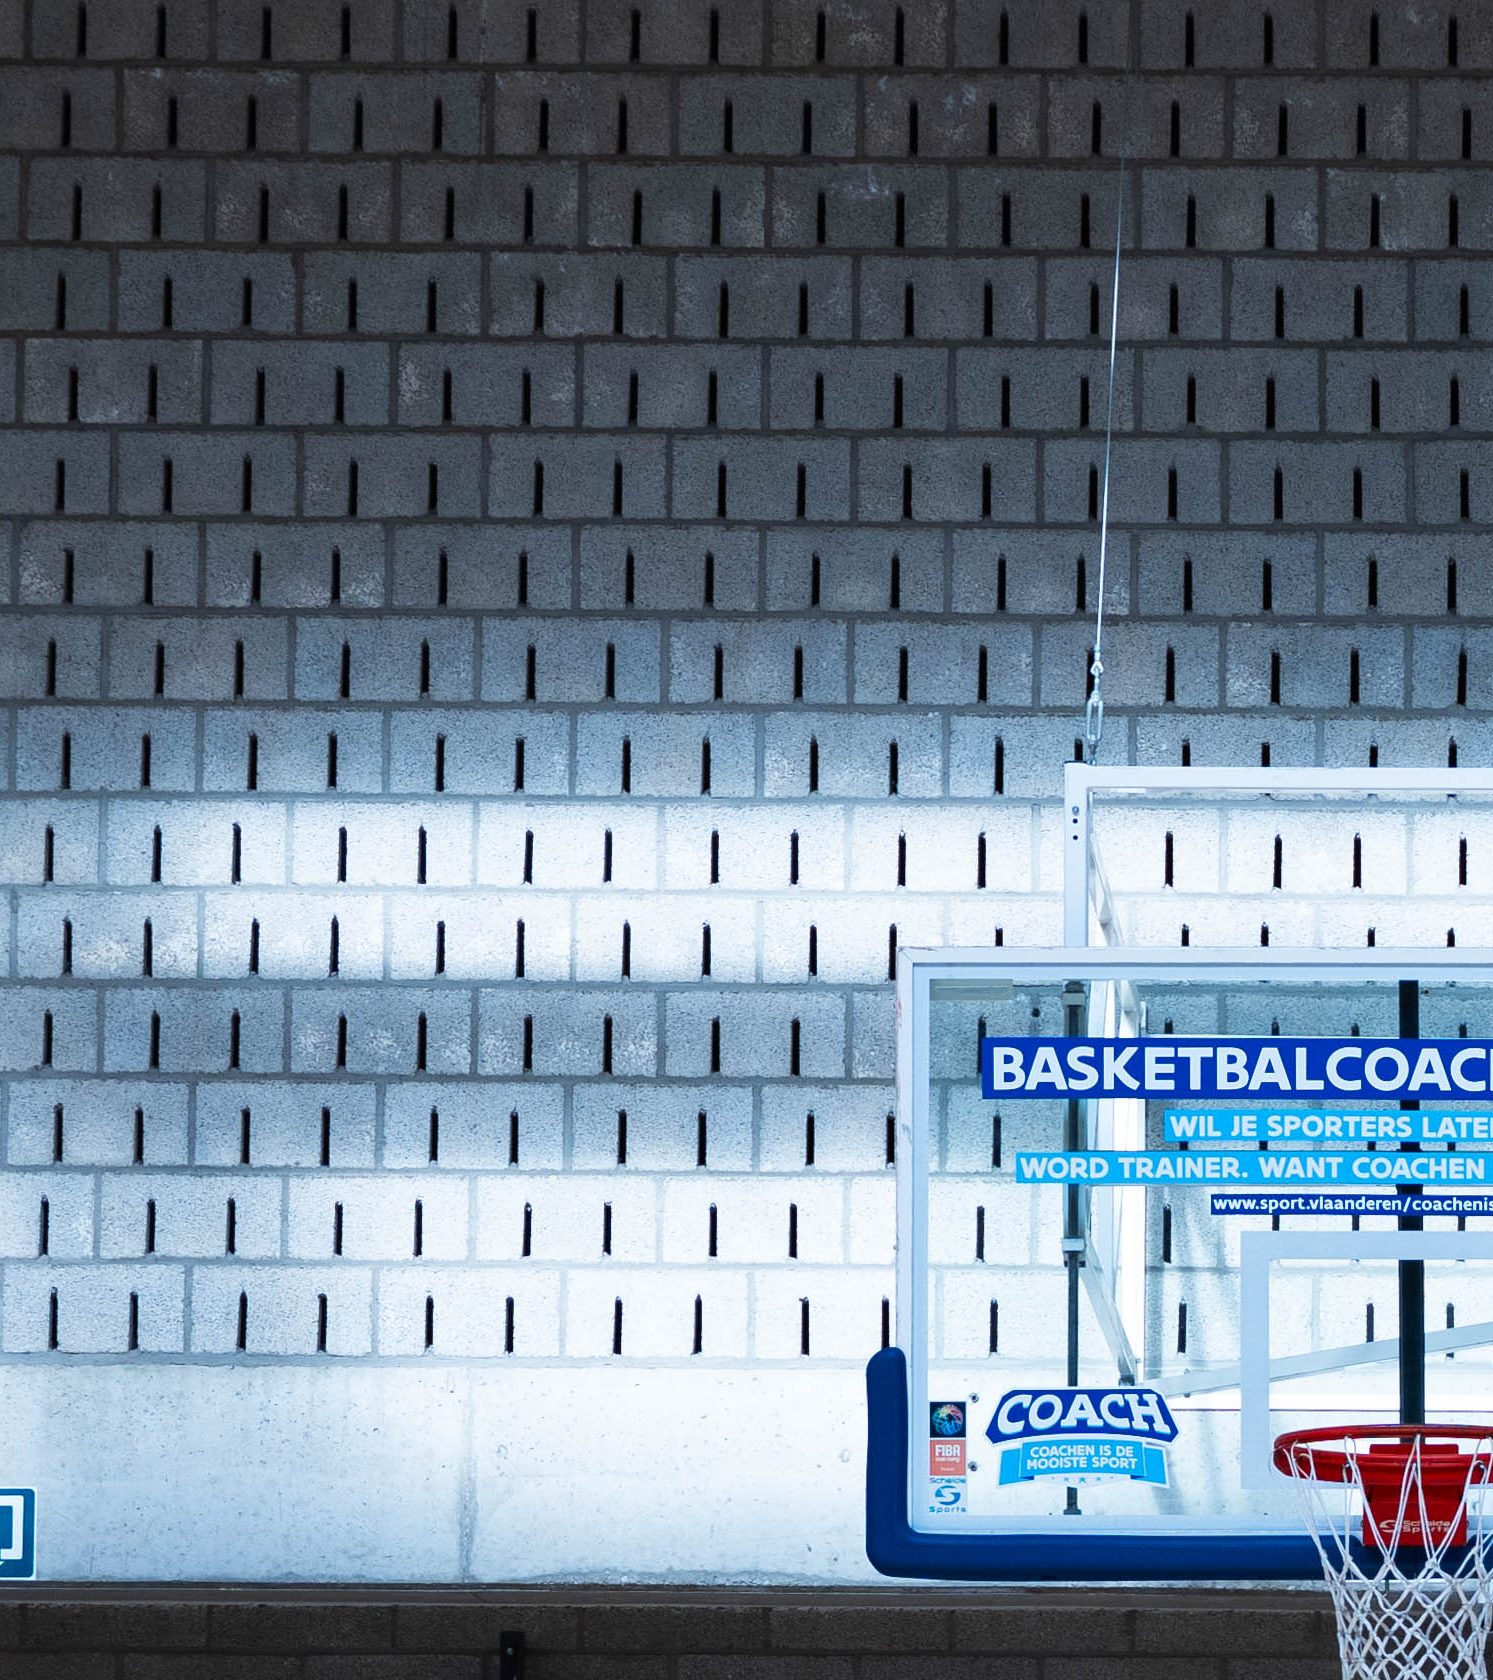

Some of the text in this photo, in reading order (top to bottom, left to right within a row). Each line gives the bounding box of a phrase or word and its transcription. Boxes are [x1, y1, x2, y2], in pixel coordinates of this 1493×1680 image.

[1169, 1115, 1222, 1137] WIL
[1230, 1116, 1258, 1137] JE
[1267, 1115, 1413, 1138] SPORTERS
[1020, 1157, 1109, 1179] WORD
[1118, 1157, 1249, 1179] TRAINER.
[1258, 1157, 1344, 1179] WANT
[1351, 1157, 1485, 1180] COACHEN
[996, 1393, 1172, 1435] COACH
[935, 1444, 960, 1457] FIBA
[1029, 1444, 1134, 1458] COACHEN IS DE
[1026, 1457, 1138, 1470] MOOISTE SPORT
[929, 1506, 967, 1514] Sports
